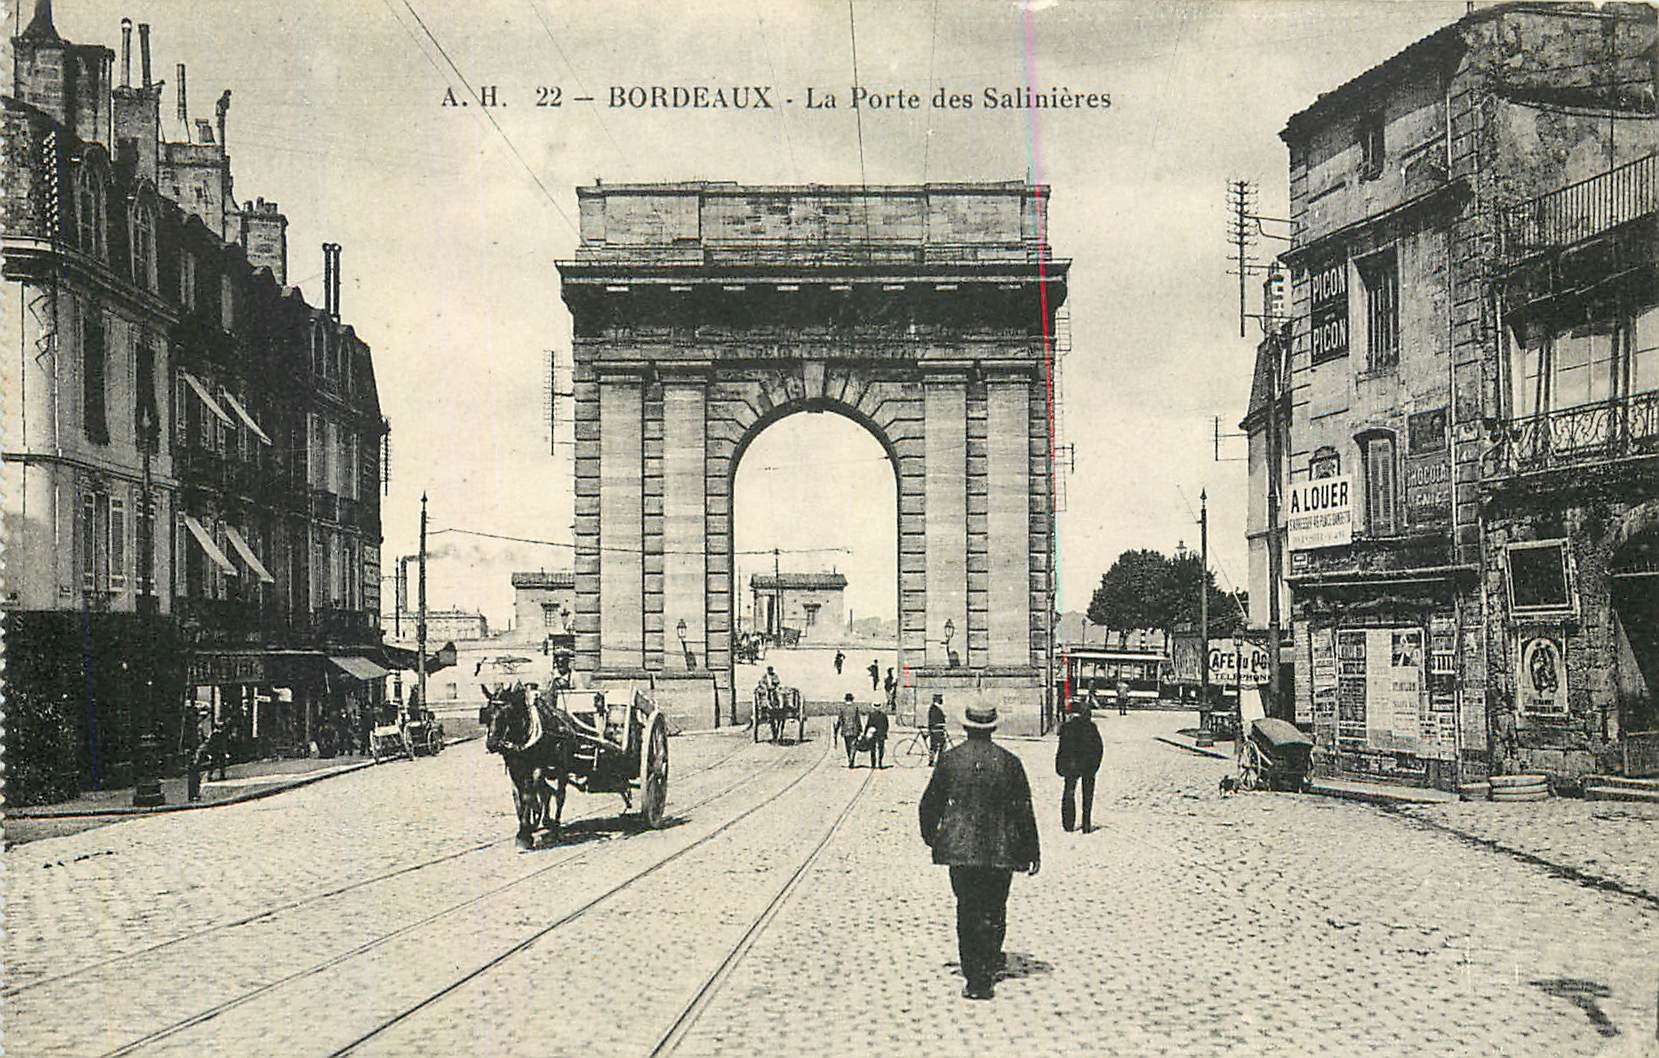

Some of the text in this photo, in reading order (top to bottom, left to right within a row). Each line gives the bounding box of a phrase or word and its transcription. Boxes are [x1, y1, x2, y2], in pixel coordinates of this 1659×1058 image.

[1312, 264, 1346, 304] PICON
[1313, 318, 1346, 354] PICON
[1291, 481, 1349, 513] A LOUER
